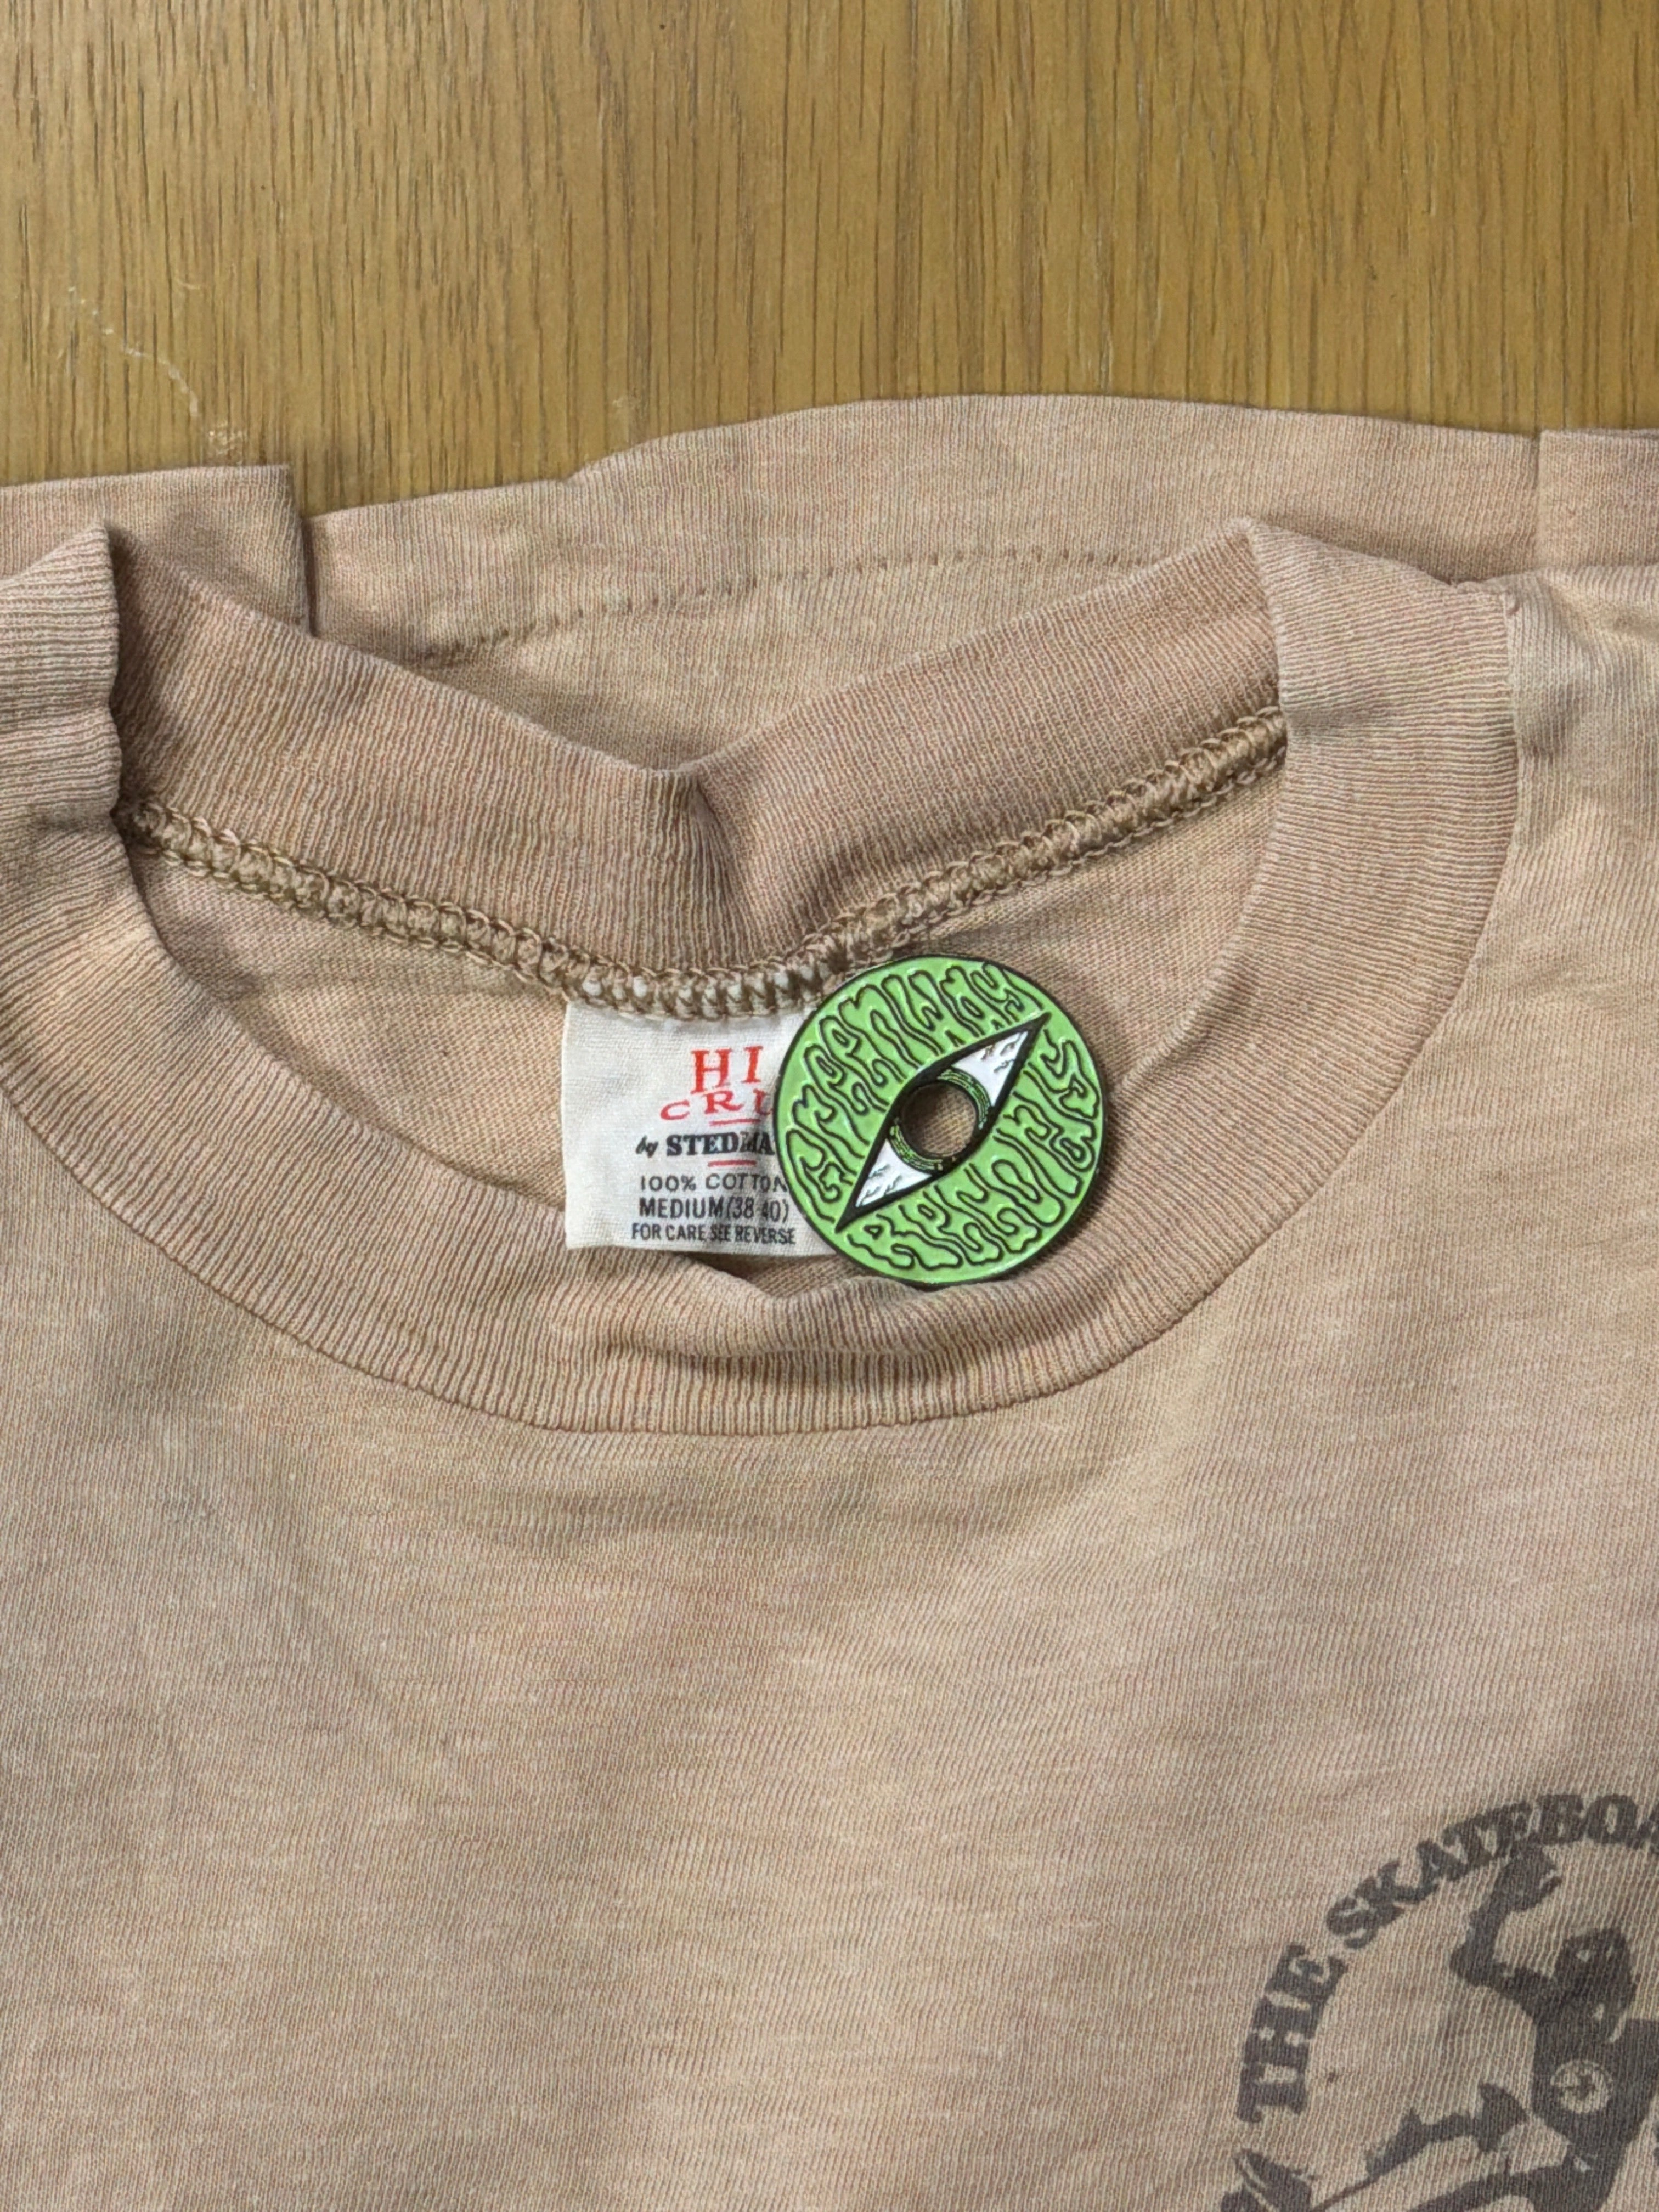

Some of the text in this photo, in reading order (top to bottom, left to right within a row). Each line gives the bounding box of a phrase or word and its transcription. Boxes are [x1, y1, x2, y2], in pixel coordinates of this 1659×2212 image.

[635, 1131, 775, 1158] by STEDMA
[640, 1172, 788, 1193] 100% COTTON
[631, 1222, 797, 1245] FOR CARE SEE REVERSE
[1235, 1943, 1348, 2123] THE
